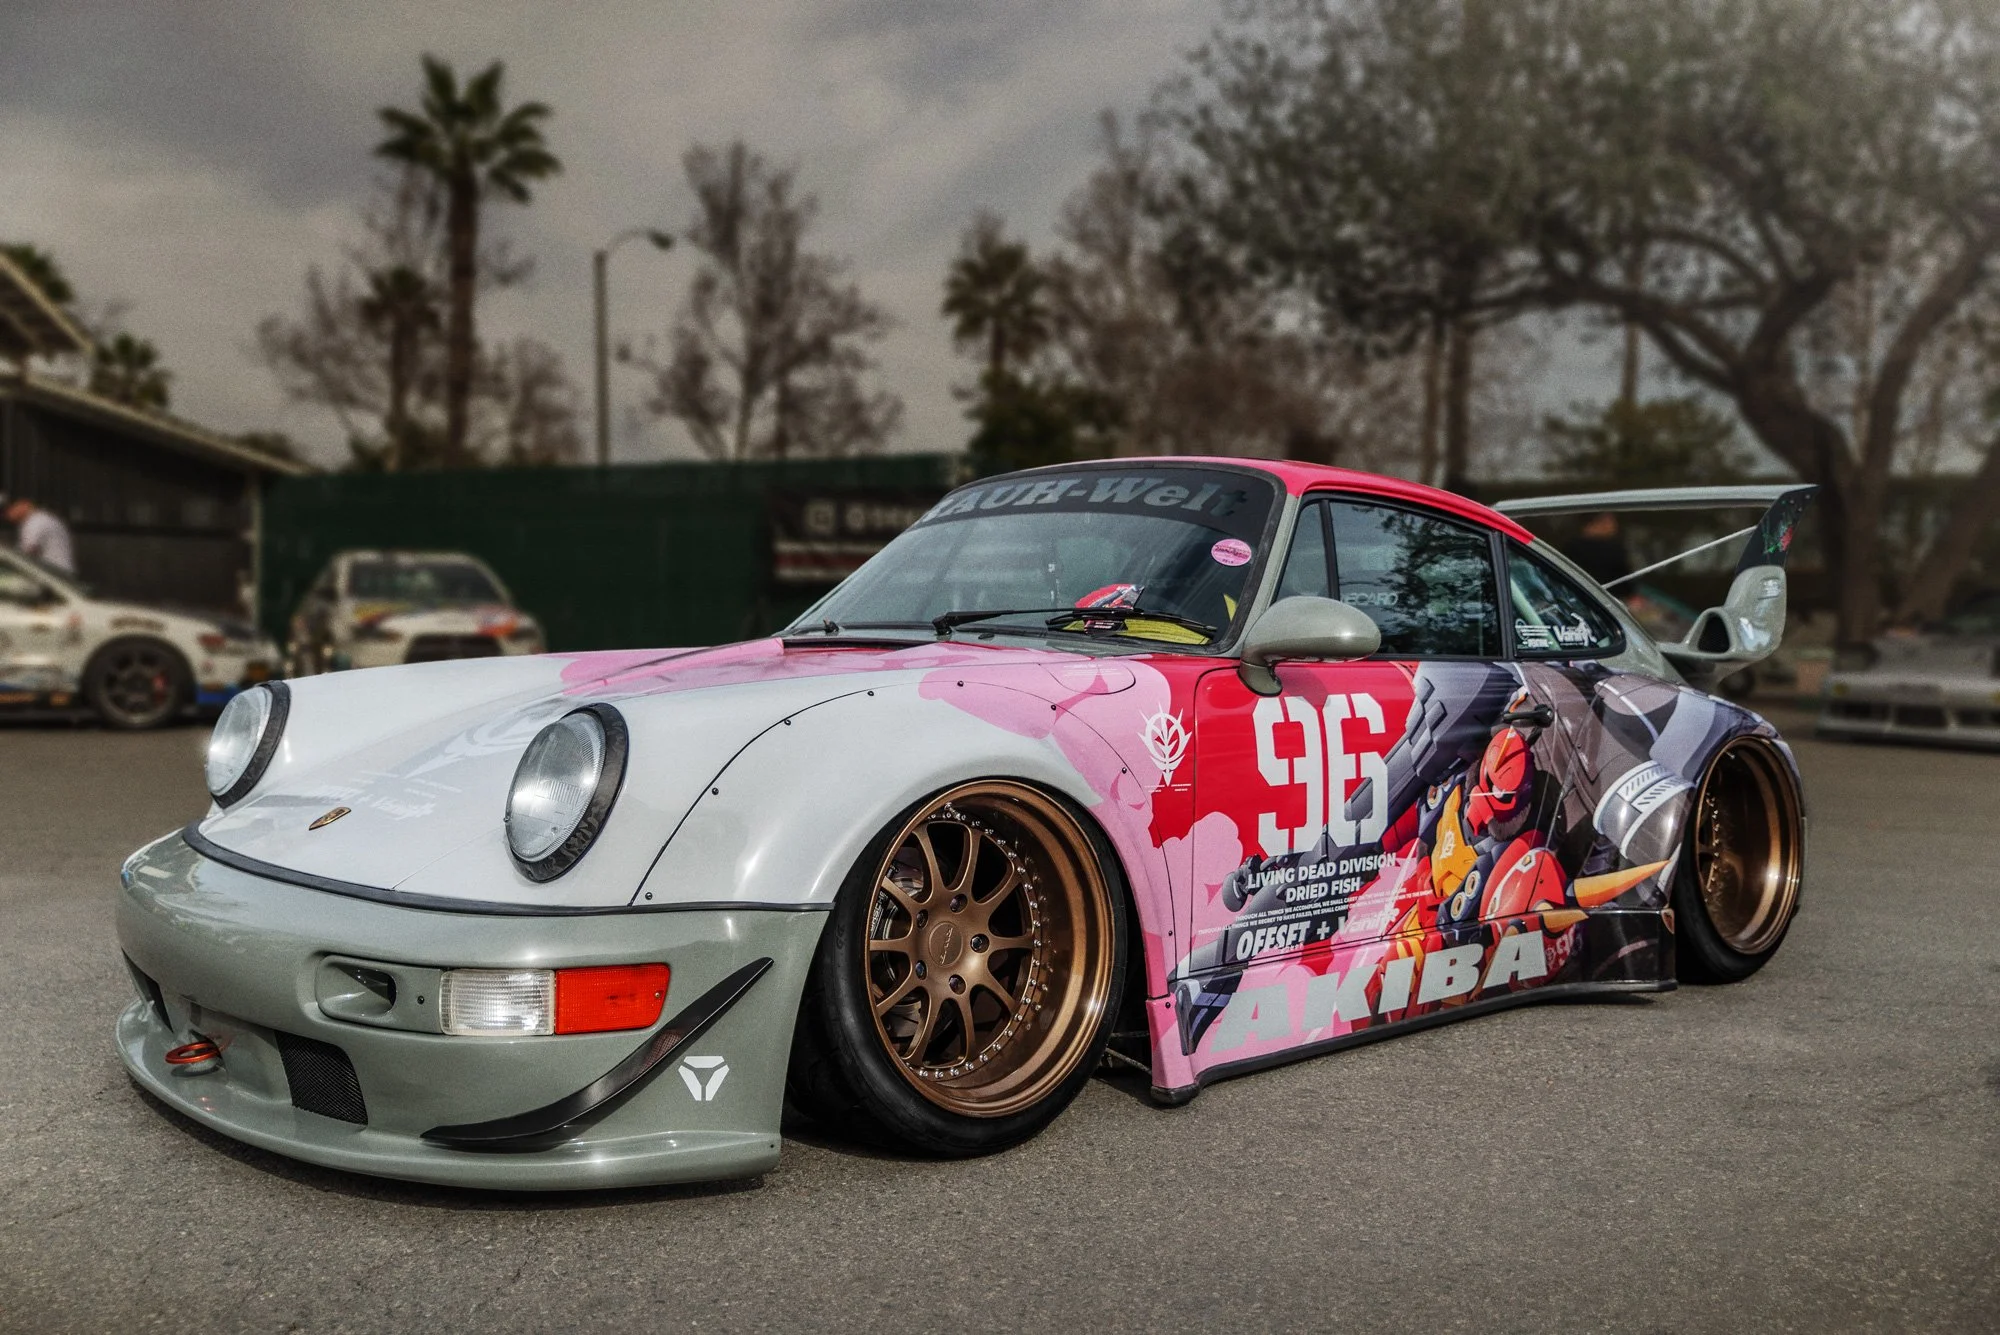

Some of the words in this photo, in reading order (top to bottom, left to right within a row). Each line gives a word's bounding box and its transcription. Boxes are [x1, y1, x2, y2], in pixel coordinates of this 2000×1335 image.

[1252, 693, 1388, 857] 96
[1247, 868, 1295, 889] LIVING
[1298, 862, 1336, 881] DEAD
[1339, 853, 1396, 875] DIVISION
[1286, 882, 1328, 903] DRIED
[1331, 877, 1361, 896] FISH
[1210, 930, 1548, 1054] AKIBA
